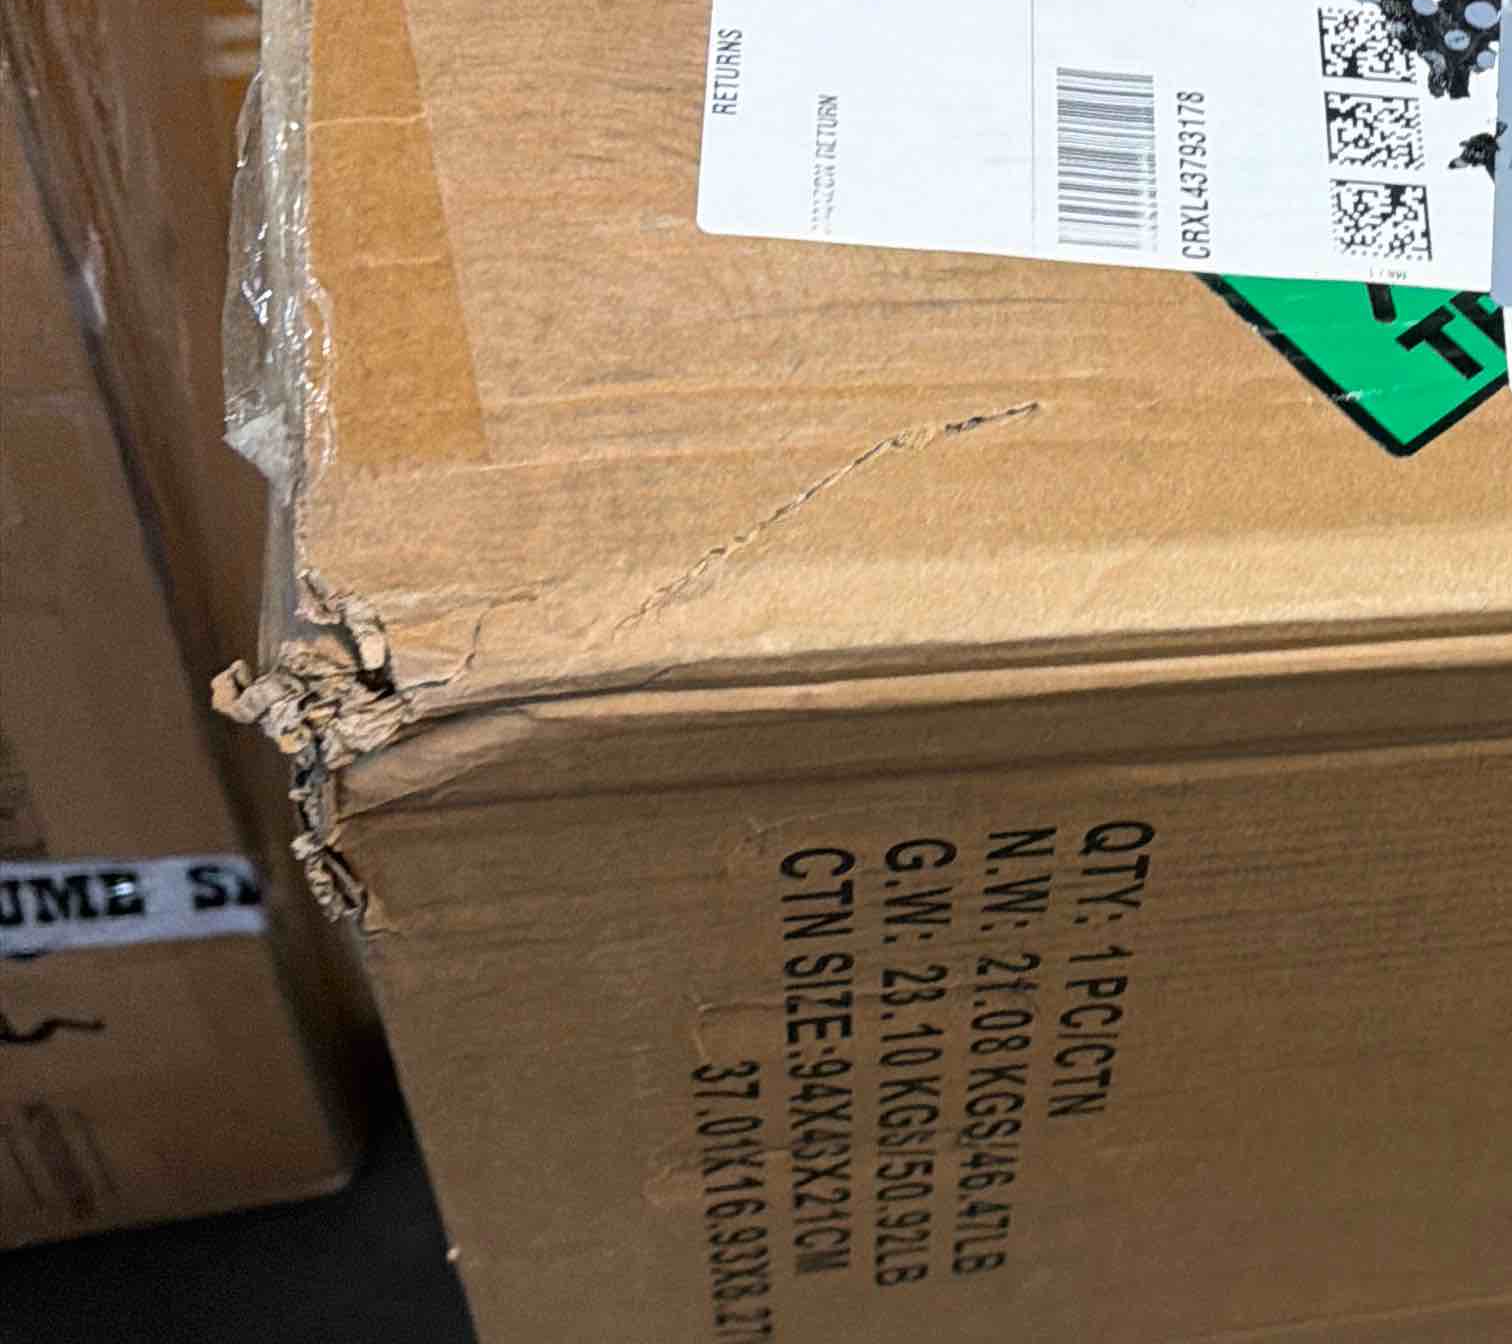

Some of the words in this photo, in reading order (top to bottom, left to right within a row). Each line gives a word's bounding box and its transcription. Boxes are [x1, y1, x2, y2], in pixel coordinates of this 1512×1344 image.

[711, 29, 744, 116] RETURNS
[1177, 90, 1212, 260] CRXL43793178
[779, 846, 857, 942] CTN
[882, 837, 958, 945] G.W:
[979, 825, 1059, 932] N.W:
[1073, 819, 1157, 926] QTY:
[968, 952, 1042, 1056] 21.08
[1069, 944, 1133, 964] 1
[878, 964, 949, 1070] 23.10
